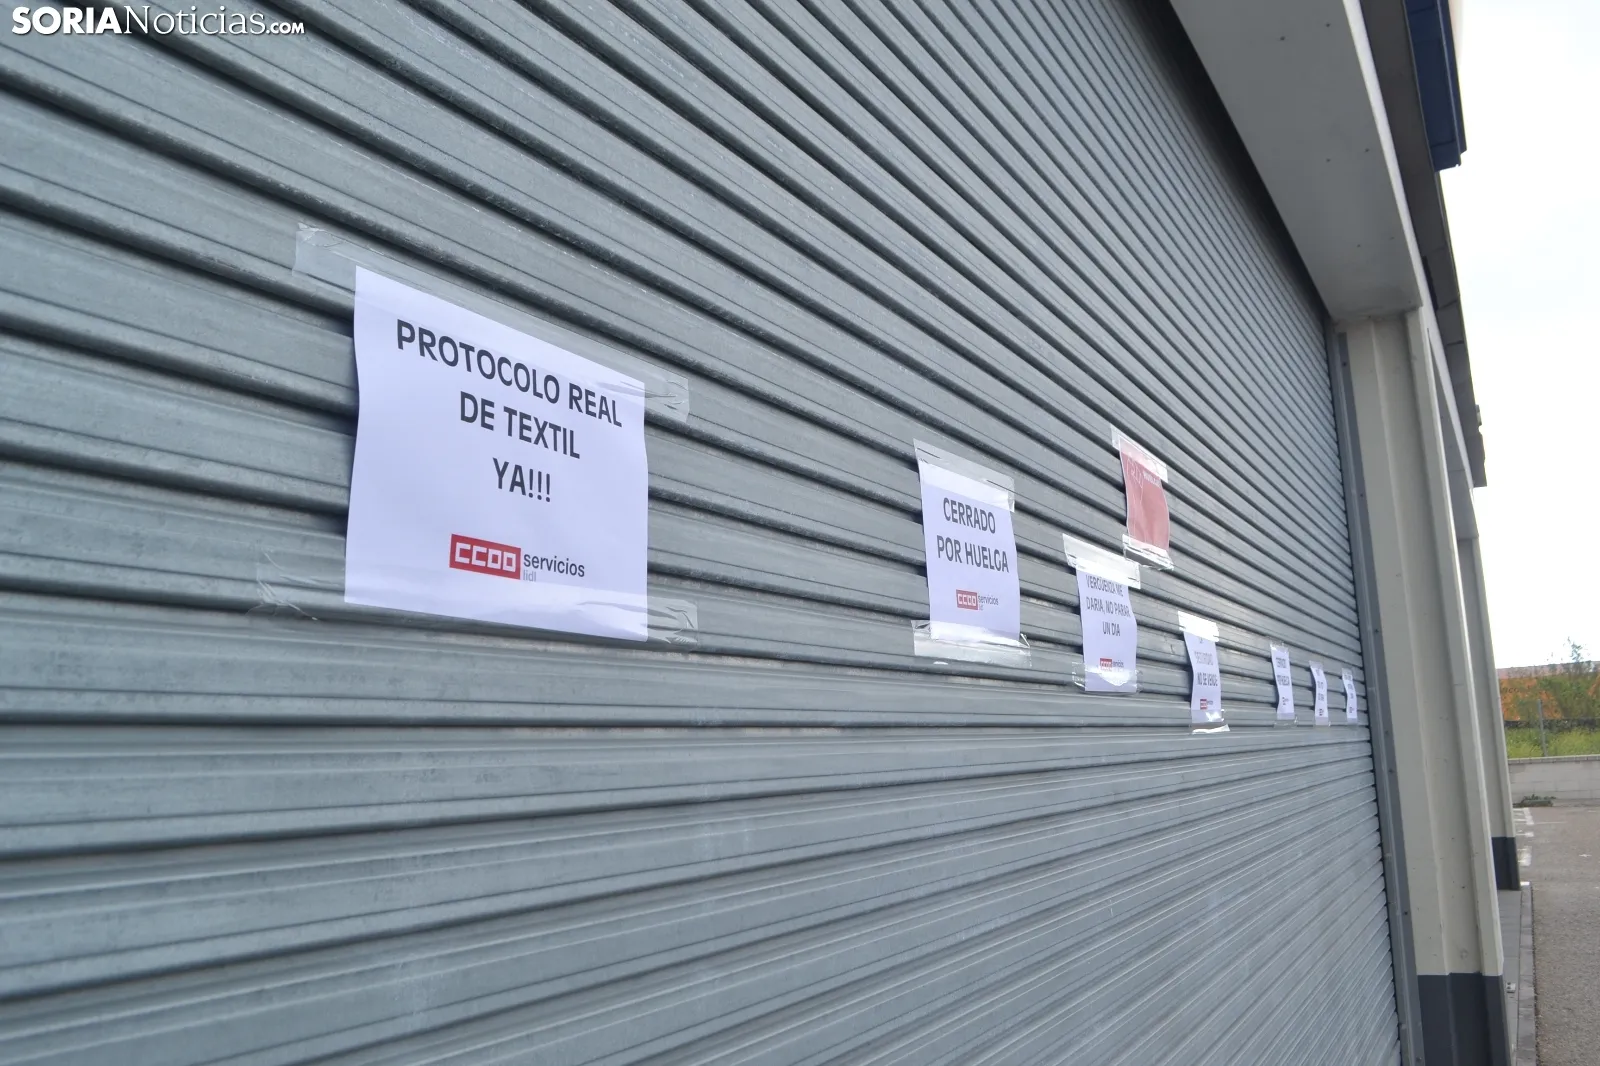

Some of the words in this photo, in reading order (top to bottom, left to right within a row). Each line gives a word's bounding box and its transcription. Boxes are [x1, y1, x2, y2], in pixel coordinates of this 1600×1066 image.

[397, 319, 560, 404] PROTOCOLO
[568, 382, 622, 428] REAL
[460, 391, 495, 431] DE
[503, 406, 581, 459] TEXTIL
[492, 457, 551, 502] YA!!!
[943, 497, 996, 534] CERRADO
[454, 541, 518, 574] CCOO
[523, 553, 585, 578] servicios
[937, 535, 962, 564] POR
[965, 542, 1009, 573] HUELGA
[523, 569, 537, 582] lidl
[1106, 600, 1114, 614] NO
[1102, 621, 1111, 635] UN
